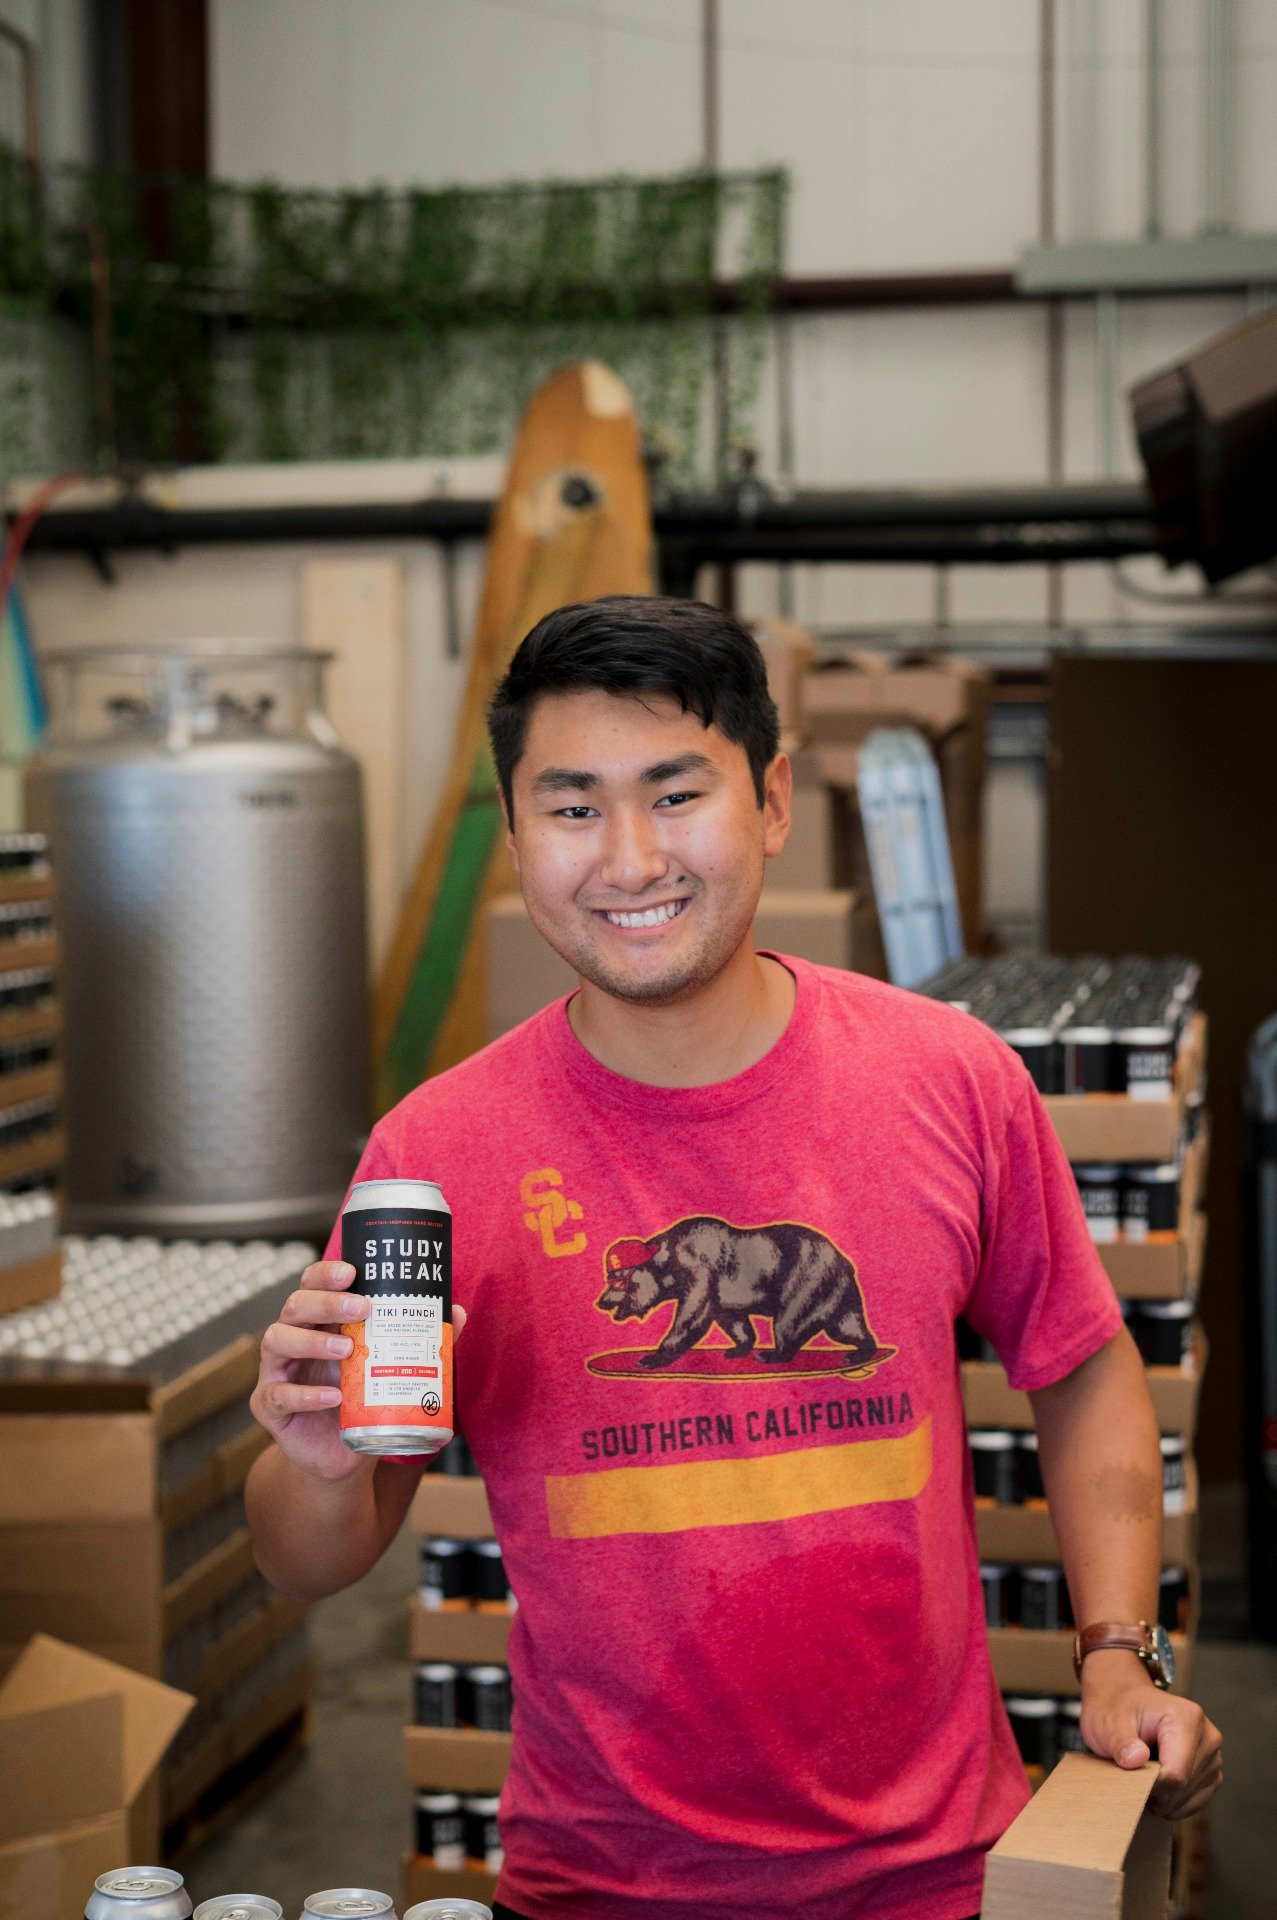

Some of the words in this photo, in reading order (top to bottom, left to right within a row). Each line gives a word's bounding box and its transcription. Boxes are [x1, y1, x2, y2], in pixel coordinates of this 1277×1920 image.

[521, 1166, 588, 1258] SC
[365, 1239, 443, 1259] STUDY
[365, 1262, 443, 1282] BREAK
[376, 1308, 397, 1317] TIKI
[402, 1308, 435, 1318] PUNCH
[582, 1414, 734, 1461] SOUTHERN
[746, 1391, 915, 1442] CALIFORNIA
